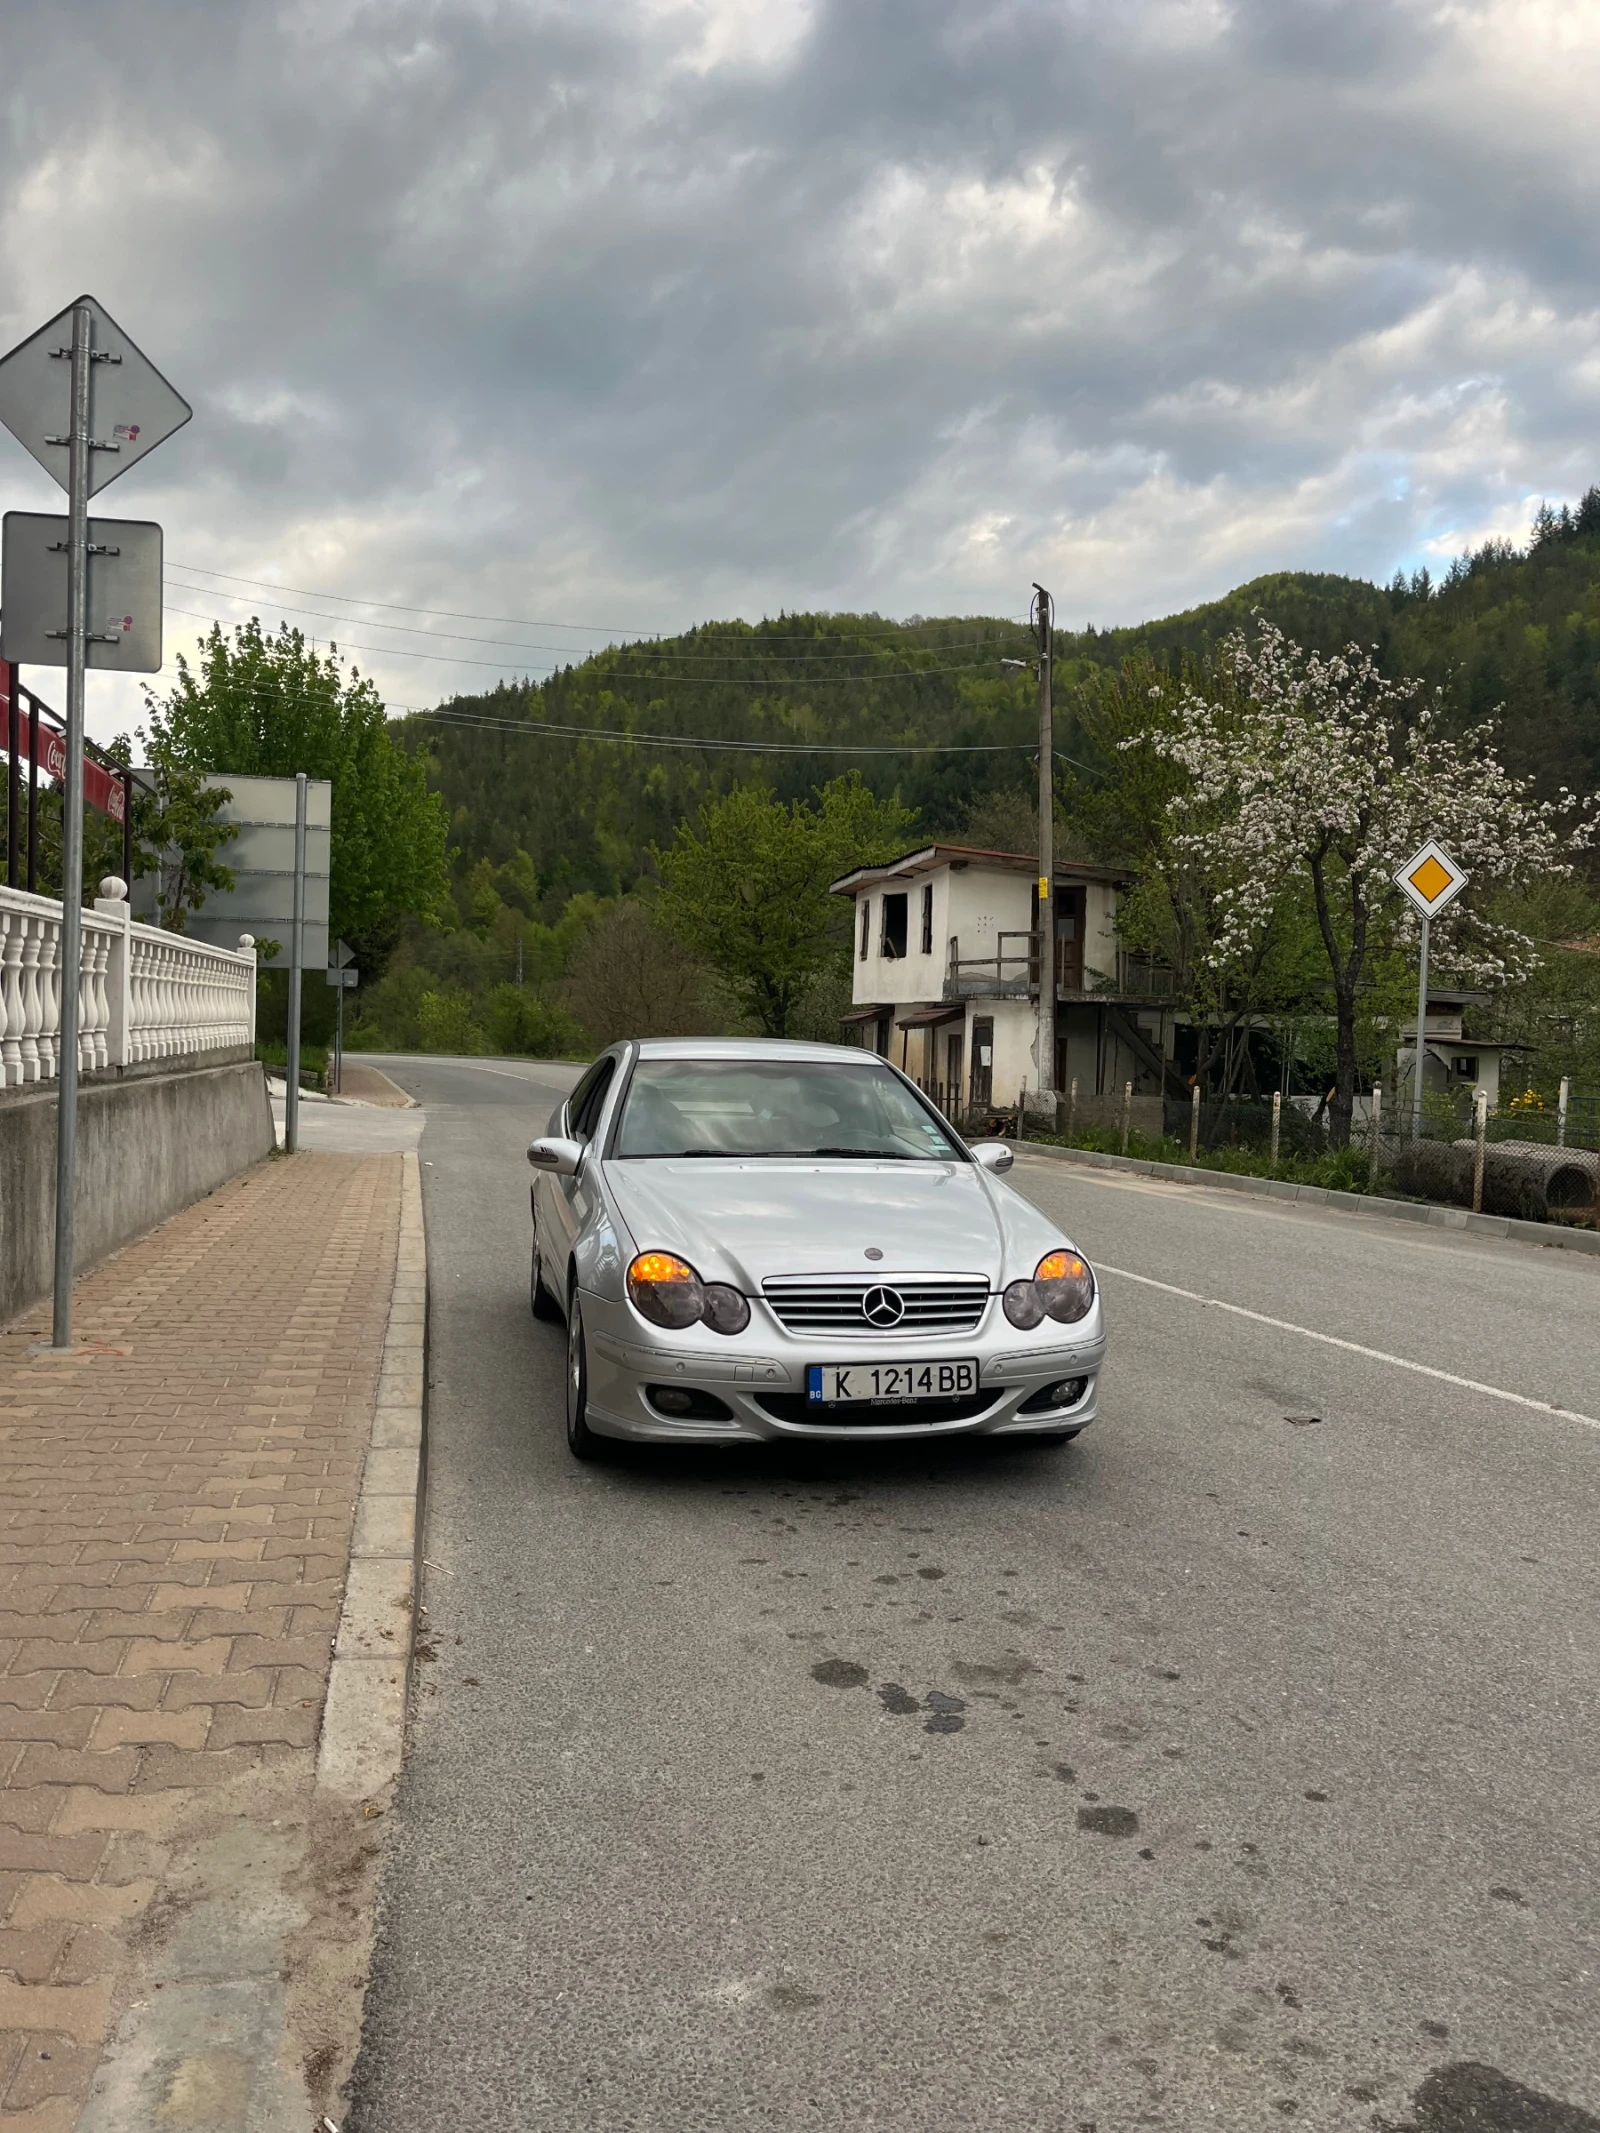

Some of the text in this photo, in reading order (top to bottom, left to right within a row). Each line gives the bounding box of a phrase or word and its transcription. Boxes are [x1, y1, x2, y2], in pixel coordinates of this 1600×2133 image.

[835, 1368, 852, 1398] K
[809, 1390, 822, 1399] BG
[870, 1397, 918, 1405] Mercedes-Benz
